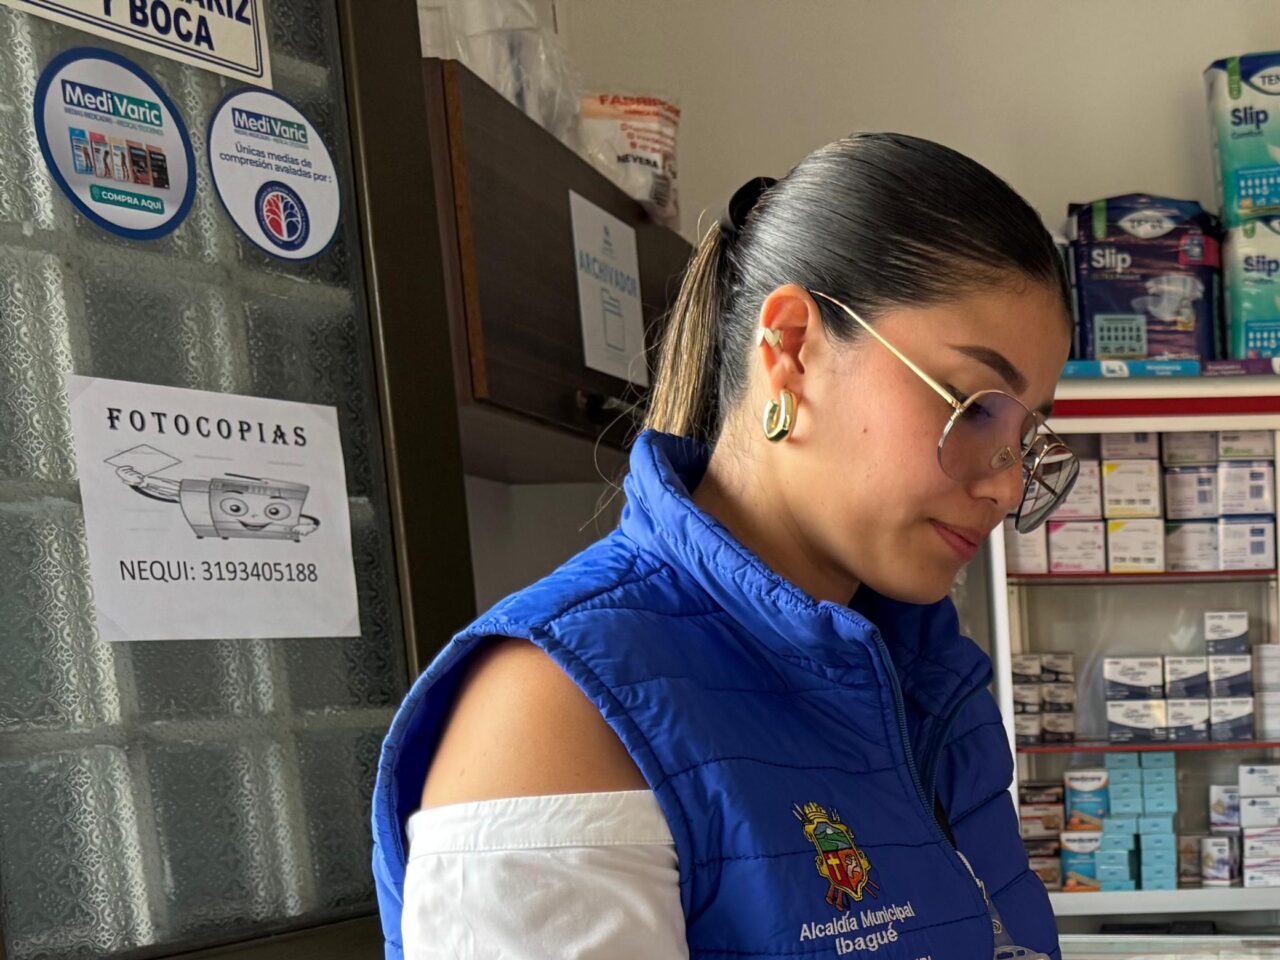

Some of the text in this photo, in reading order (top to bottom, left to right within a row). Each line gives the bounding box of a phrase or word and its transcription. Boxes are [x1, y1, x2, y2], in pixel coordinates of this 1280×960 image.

[129, 0, 215, 51] BOCA
[1231, 107, 1269, 130] Slip
[219, 151, 272, 172] compresión
[275, 163, 312, 179] avaladas
[235, 141, 312, 169] Únicas medias de
[617, 153, 659, 169] NEVERA
[101, 191, 139, 204] COMPRA
[579, 249, 638, 298] ARCHIVADOR
[1091, 249, 1132, 273] Slip
[107, 407, 307, 447] FOTOCOPIAS
[120, 560, 318, 583] NEQUI: 3193405188
[800, 901, 916, 941] Alcaldía Municipal
[835, 922, 898, 955] Ibagué
